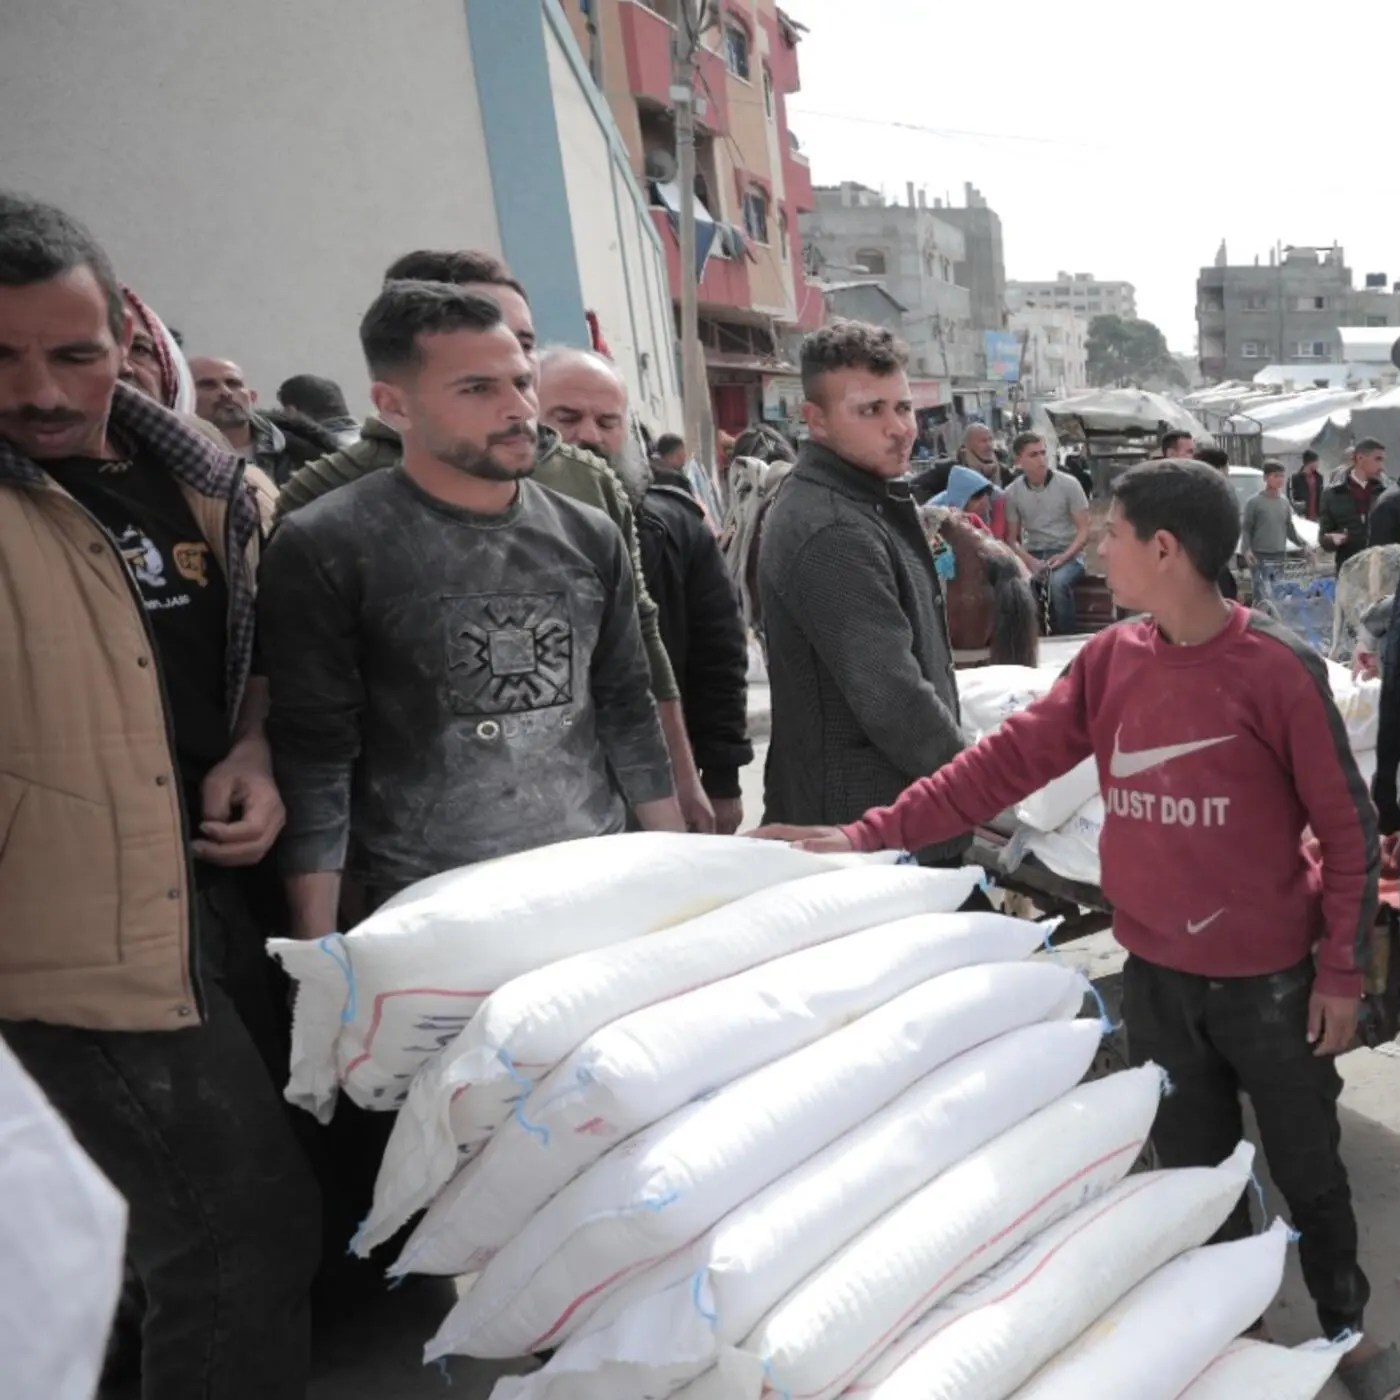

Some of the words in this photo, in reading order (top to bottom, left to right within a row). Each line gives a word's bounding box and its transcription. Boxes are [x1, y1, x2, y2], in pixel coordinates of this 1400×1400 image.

[1107, 787, 1156, 822] JUST
[1161, 796, 1196, 827] DO
[1203, 797, 1230, 827] IT
